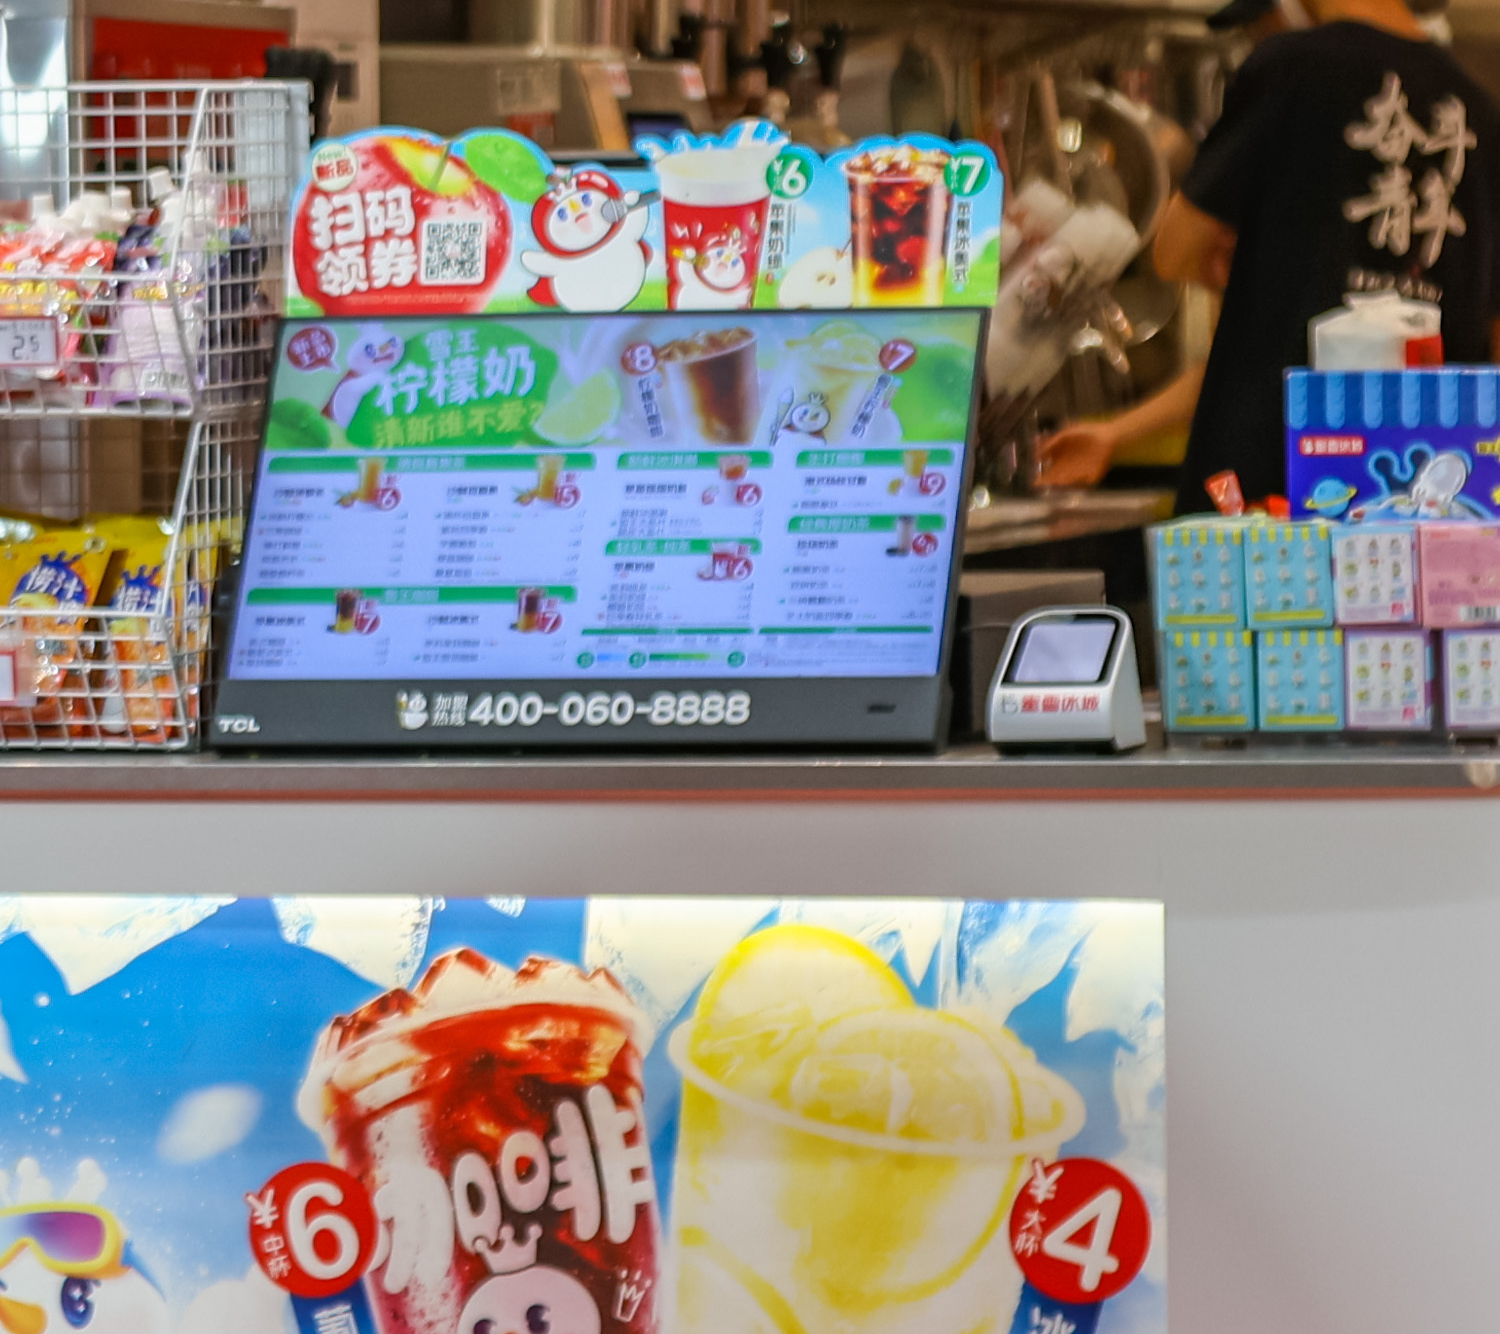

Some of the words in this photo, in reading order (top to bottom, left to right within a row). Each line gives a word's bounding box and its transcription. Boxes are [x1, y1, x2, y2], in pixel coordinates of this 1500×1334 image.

[312, 186, 416, 251] 扫码
[316, 239, 418, 297] 领券
[374, 346, 536, 417] 柠檬奶
[219, 717, 261, 734] TCL
[433, 694, 469, 711] 加盟
[470, 693, 751, 727] 400-060-8888
[262, 1233, 292, 1280] 中杯
[1014, 1208, 1047, 1258] 大杯
